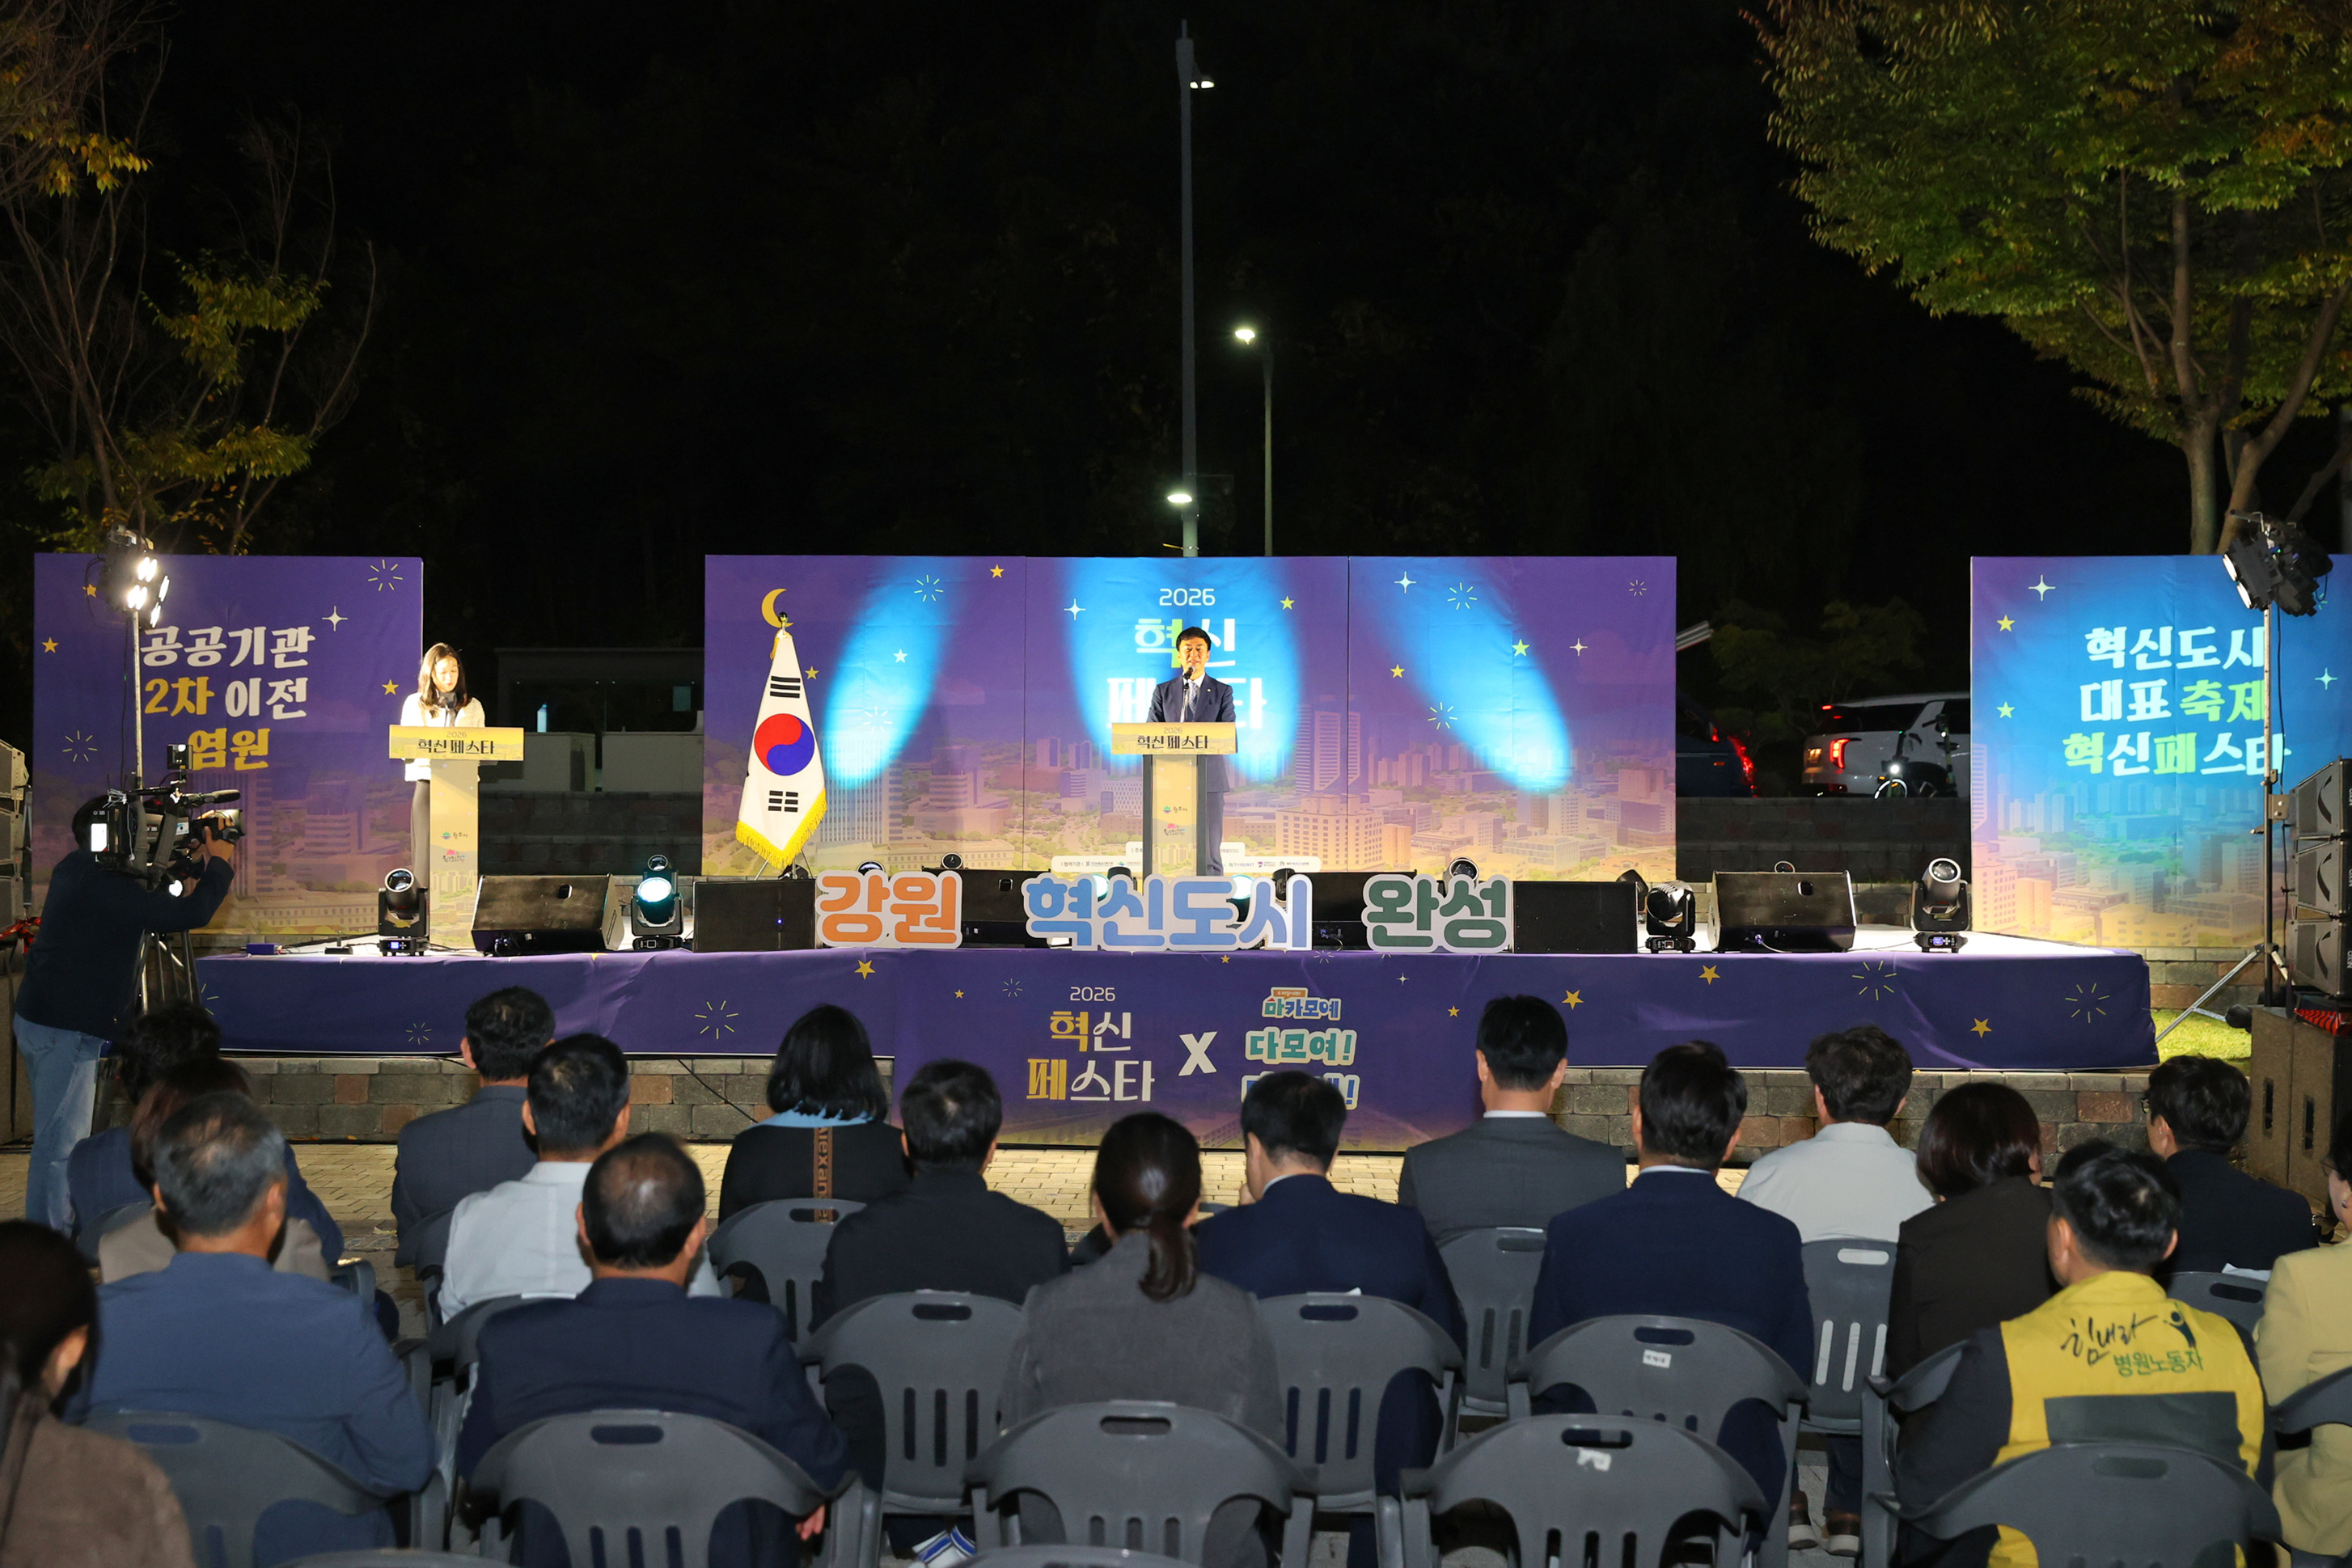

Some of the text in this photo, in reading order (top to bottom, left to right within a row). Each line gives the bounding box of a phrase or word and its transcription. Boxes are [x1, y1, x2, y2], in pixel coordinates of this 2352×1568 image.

[1159, 588, 1216, 606] 2026
[140, 625, 316, 669] 공공기관
[2084, 626, 2265, 670] 혁신도시
[144, 676, 309, 720] 2차 이전
[2079, 678, 2265, 723] 대표 축제
[188, 728, 271, 771] 염원
[2062, 731, 2292, 776] 혁신페스타
[819, 874, 1508, 948] 강원 혁신도시 완성
[1070, 987, 1115, 1002] 2026
[1050, 1010, 1131, 1052] 혁신
[1250, 1031, 1352, 1060] 다모여!
[1026, 1058, 1155, 1101] 페스타
[2113, 1348, 2203, 1377] 병원노동자
